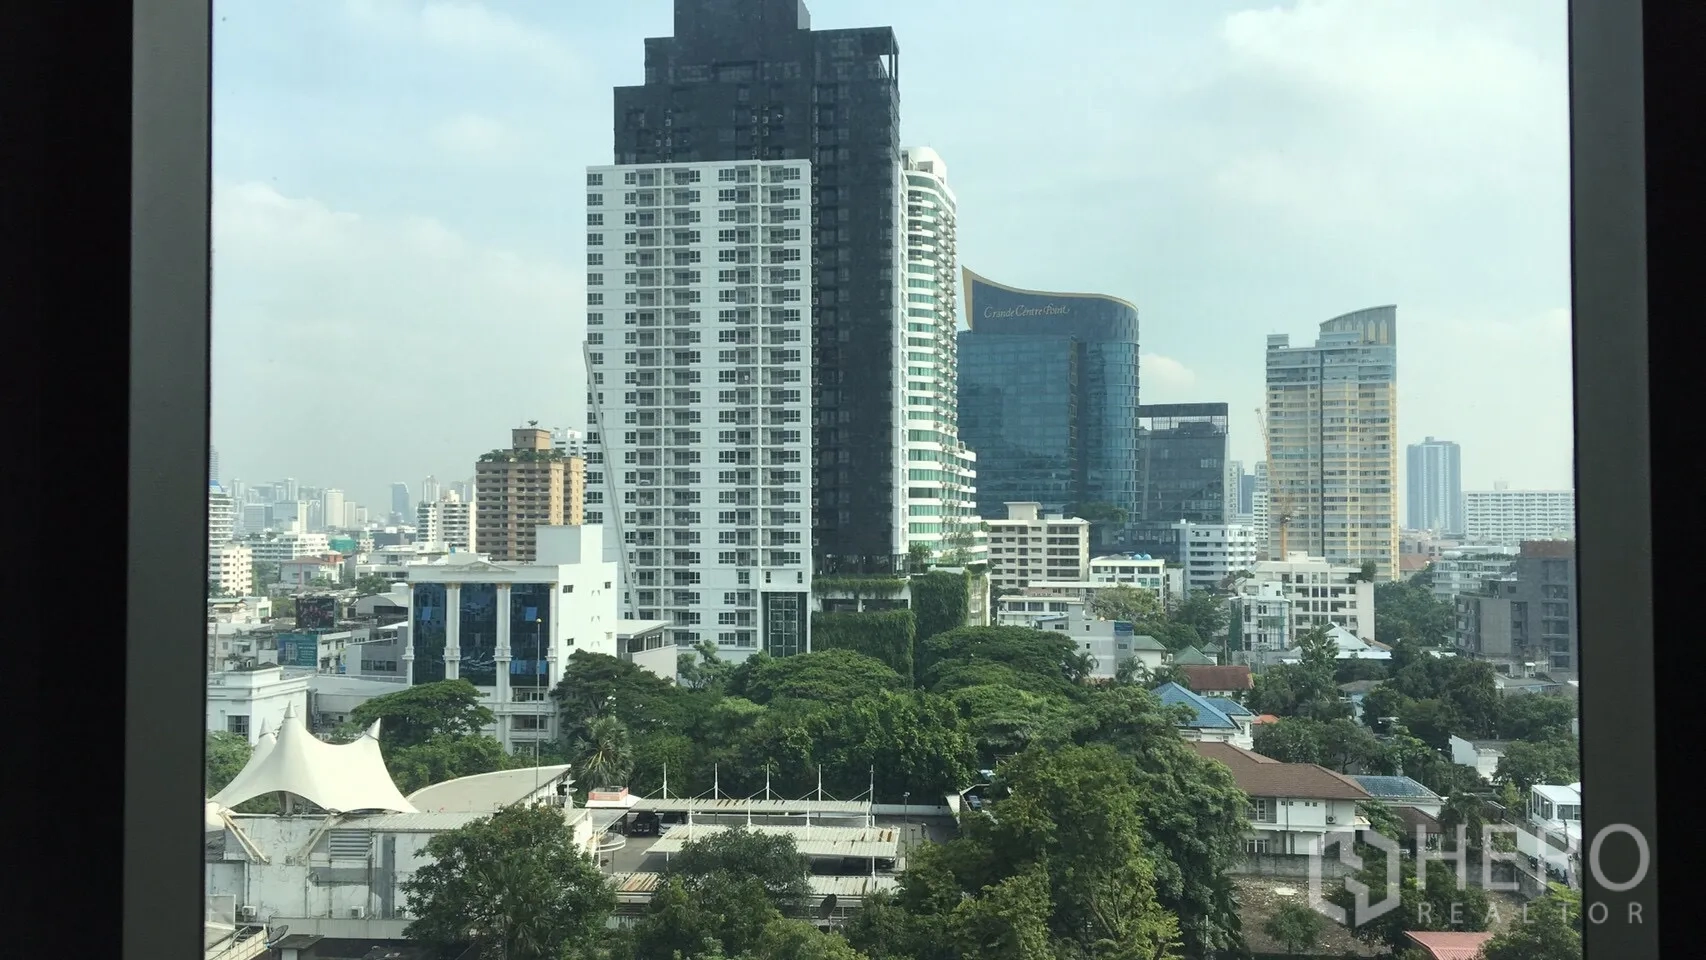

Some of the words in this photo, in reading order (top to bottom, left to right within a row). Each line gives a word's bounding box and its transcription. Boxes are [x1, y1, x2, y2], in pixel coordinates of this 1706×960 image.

[983, 305, 1014, 318] Grande
[1015, 304, 1043, 317] Centre
[1044, 302, 1070, 315] Point
